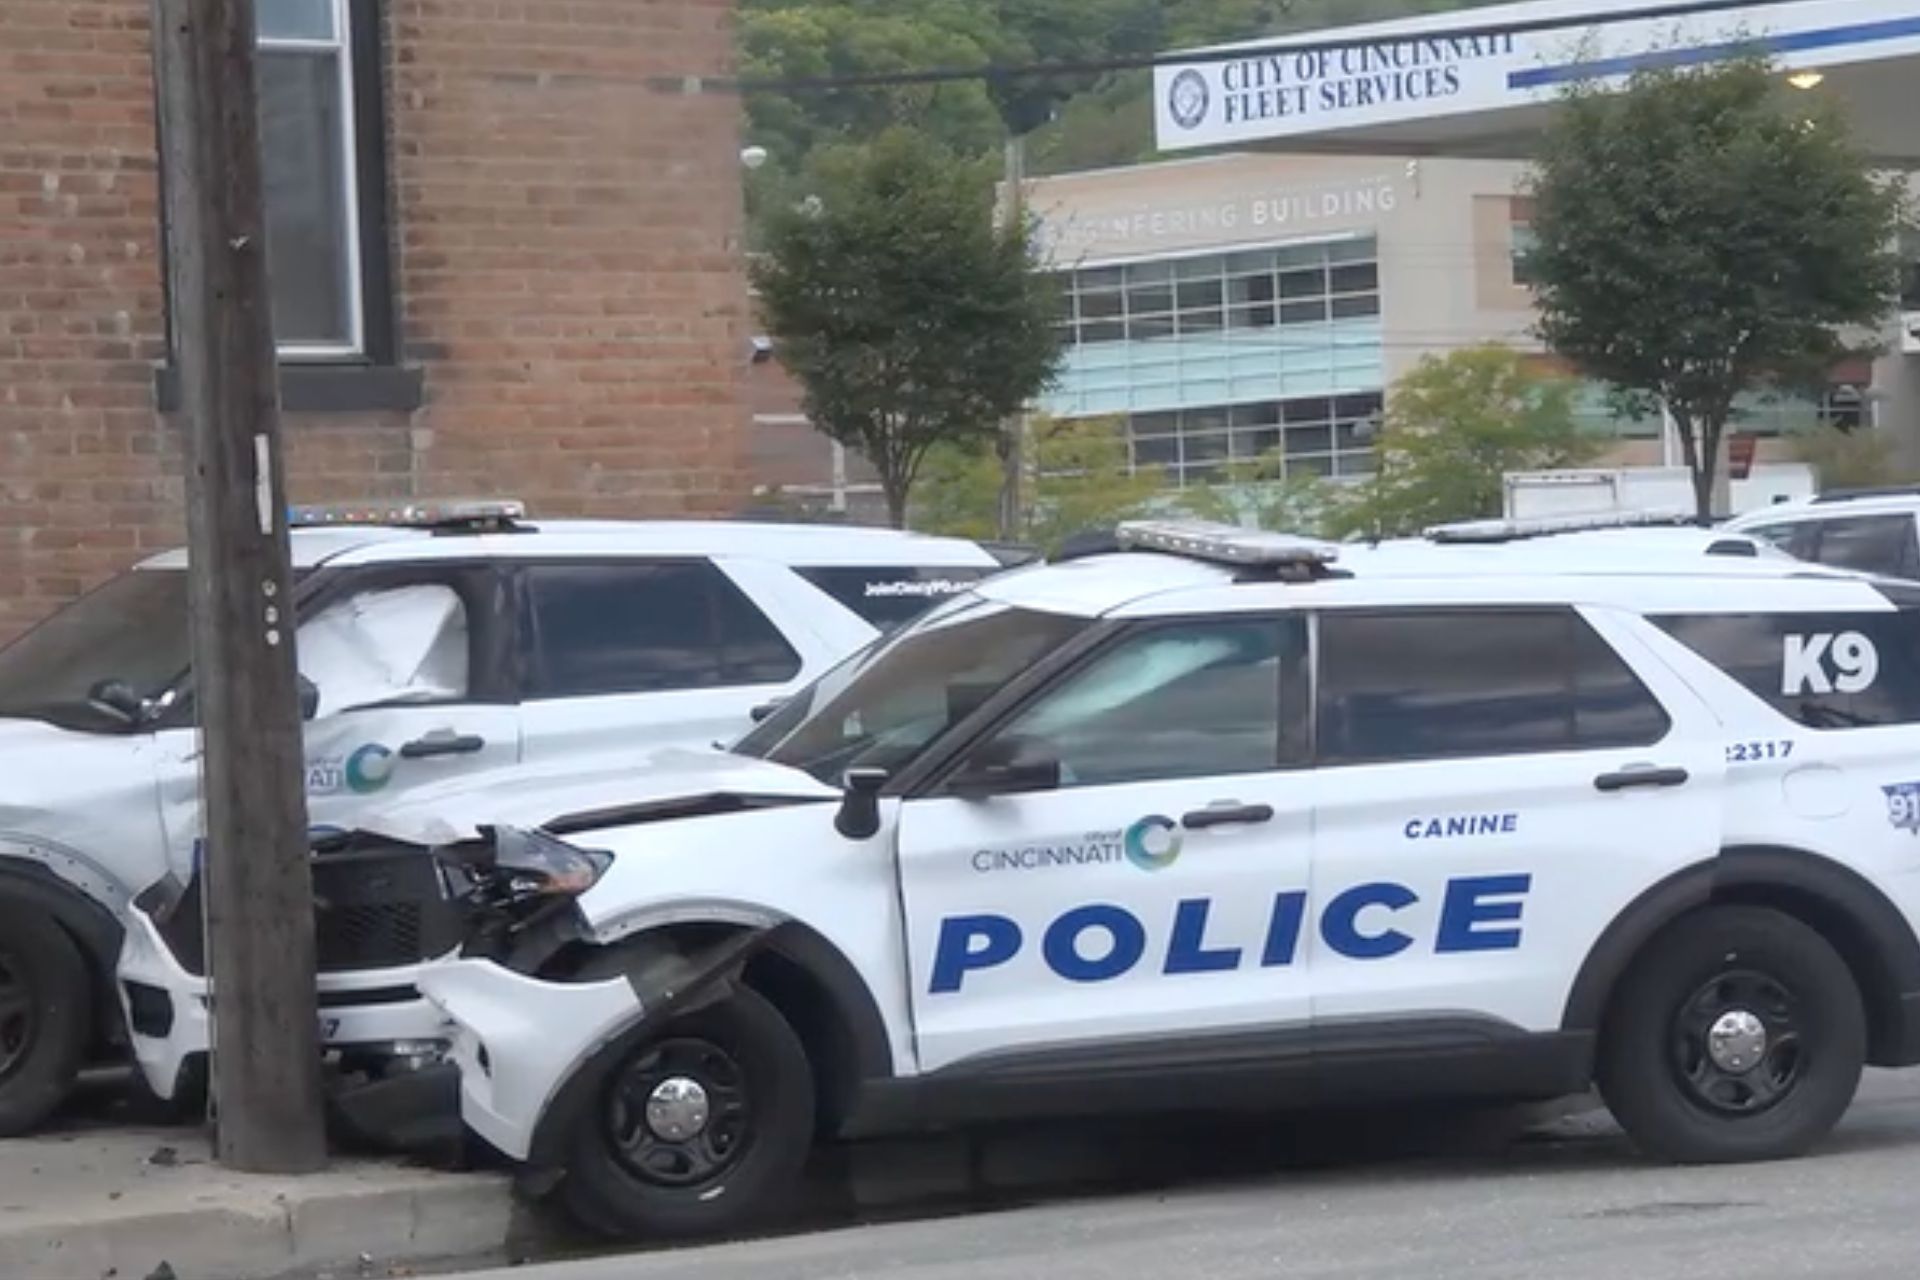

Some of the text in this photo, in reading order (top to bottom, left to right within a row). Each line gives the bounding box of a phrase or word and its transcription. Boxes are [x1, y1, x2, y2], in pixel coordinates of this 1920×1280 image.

[1222, 33, 1514, 92] CITY OF CINCINNATI
[1223, 65, 1460, 124] FLEET SERVICES
[1253, 186, 1396, 226] BUILDING
[1781, 629, 1880, 696] K9
[1404, 813, 1519, 839] CANINE
[971, 843, 1123, 872] CINCINNATI
[927, 873, 1532, 995] POLICE
